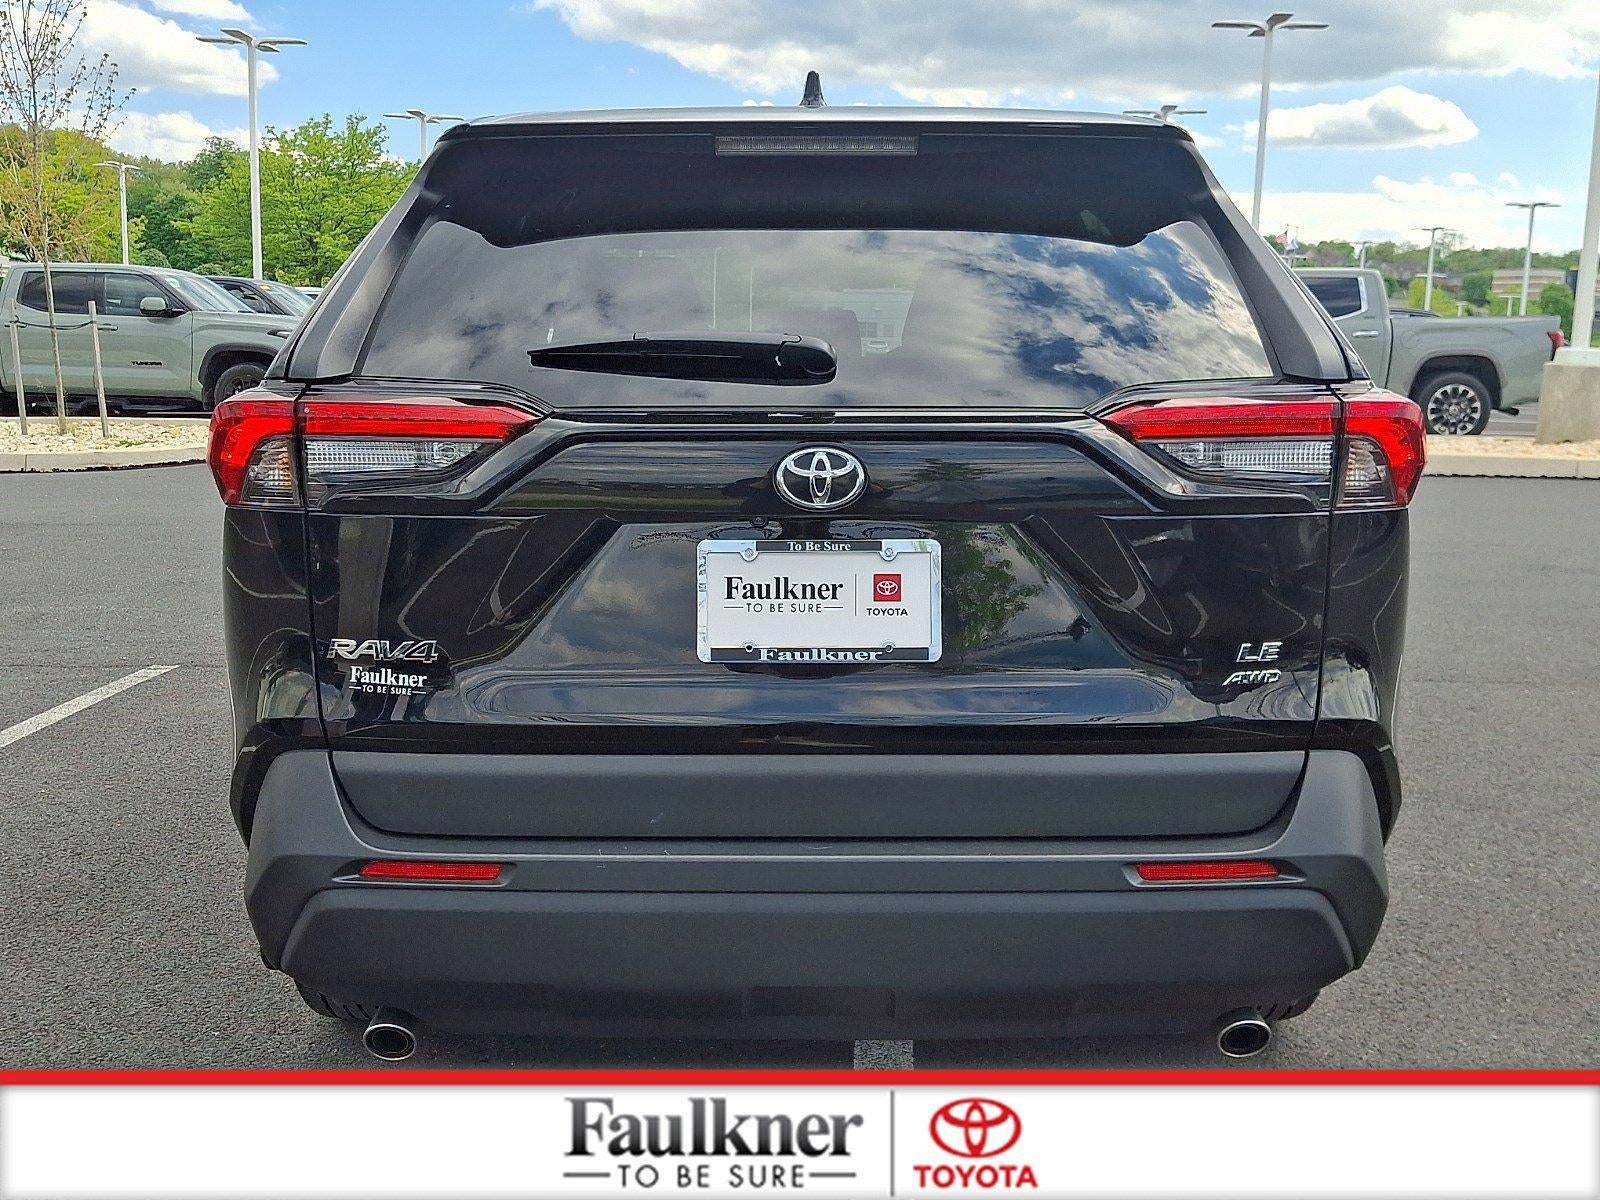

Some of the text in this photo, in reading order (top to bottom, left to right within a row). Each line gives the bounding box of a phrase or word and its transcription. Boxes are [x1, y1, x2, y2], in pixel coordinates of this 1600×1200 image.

[787, 541, 851, 551] To Be Sure
[724, 576, 843, 600] Faulkner
[746, 603, 822, 613] TO BE SURE
[866, 608, 908, 616] TOYOTA
[327, 639, 438, 663] RAV4
[758, 648, 882, 661] Faulkner
[1236, 641, 1283, 662] LE
[350, 665, 427, 687] Faulkner
[1222, 669, 1281, 686] AWD
[377, 686, 387, 694] BE
